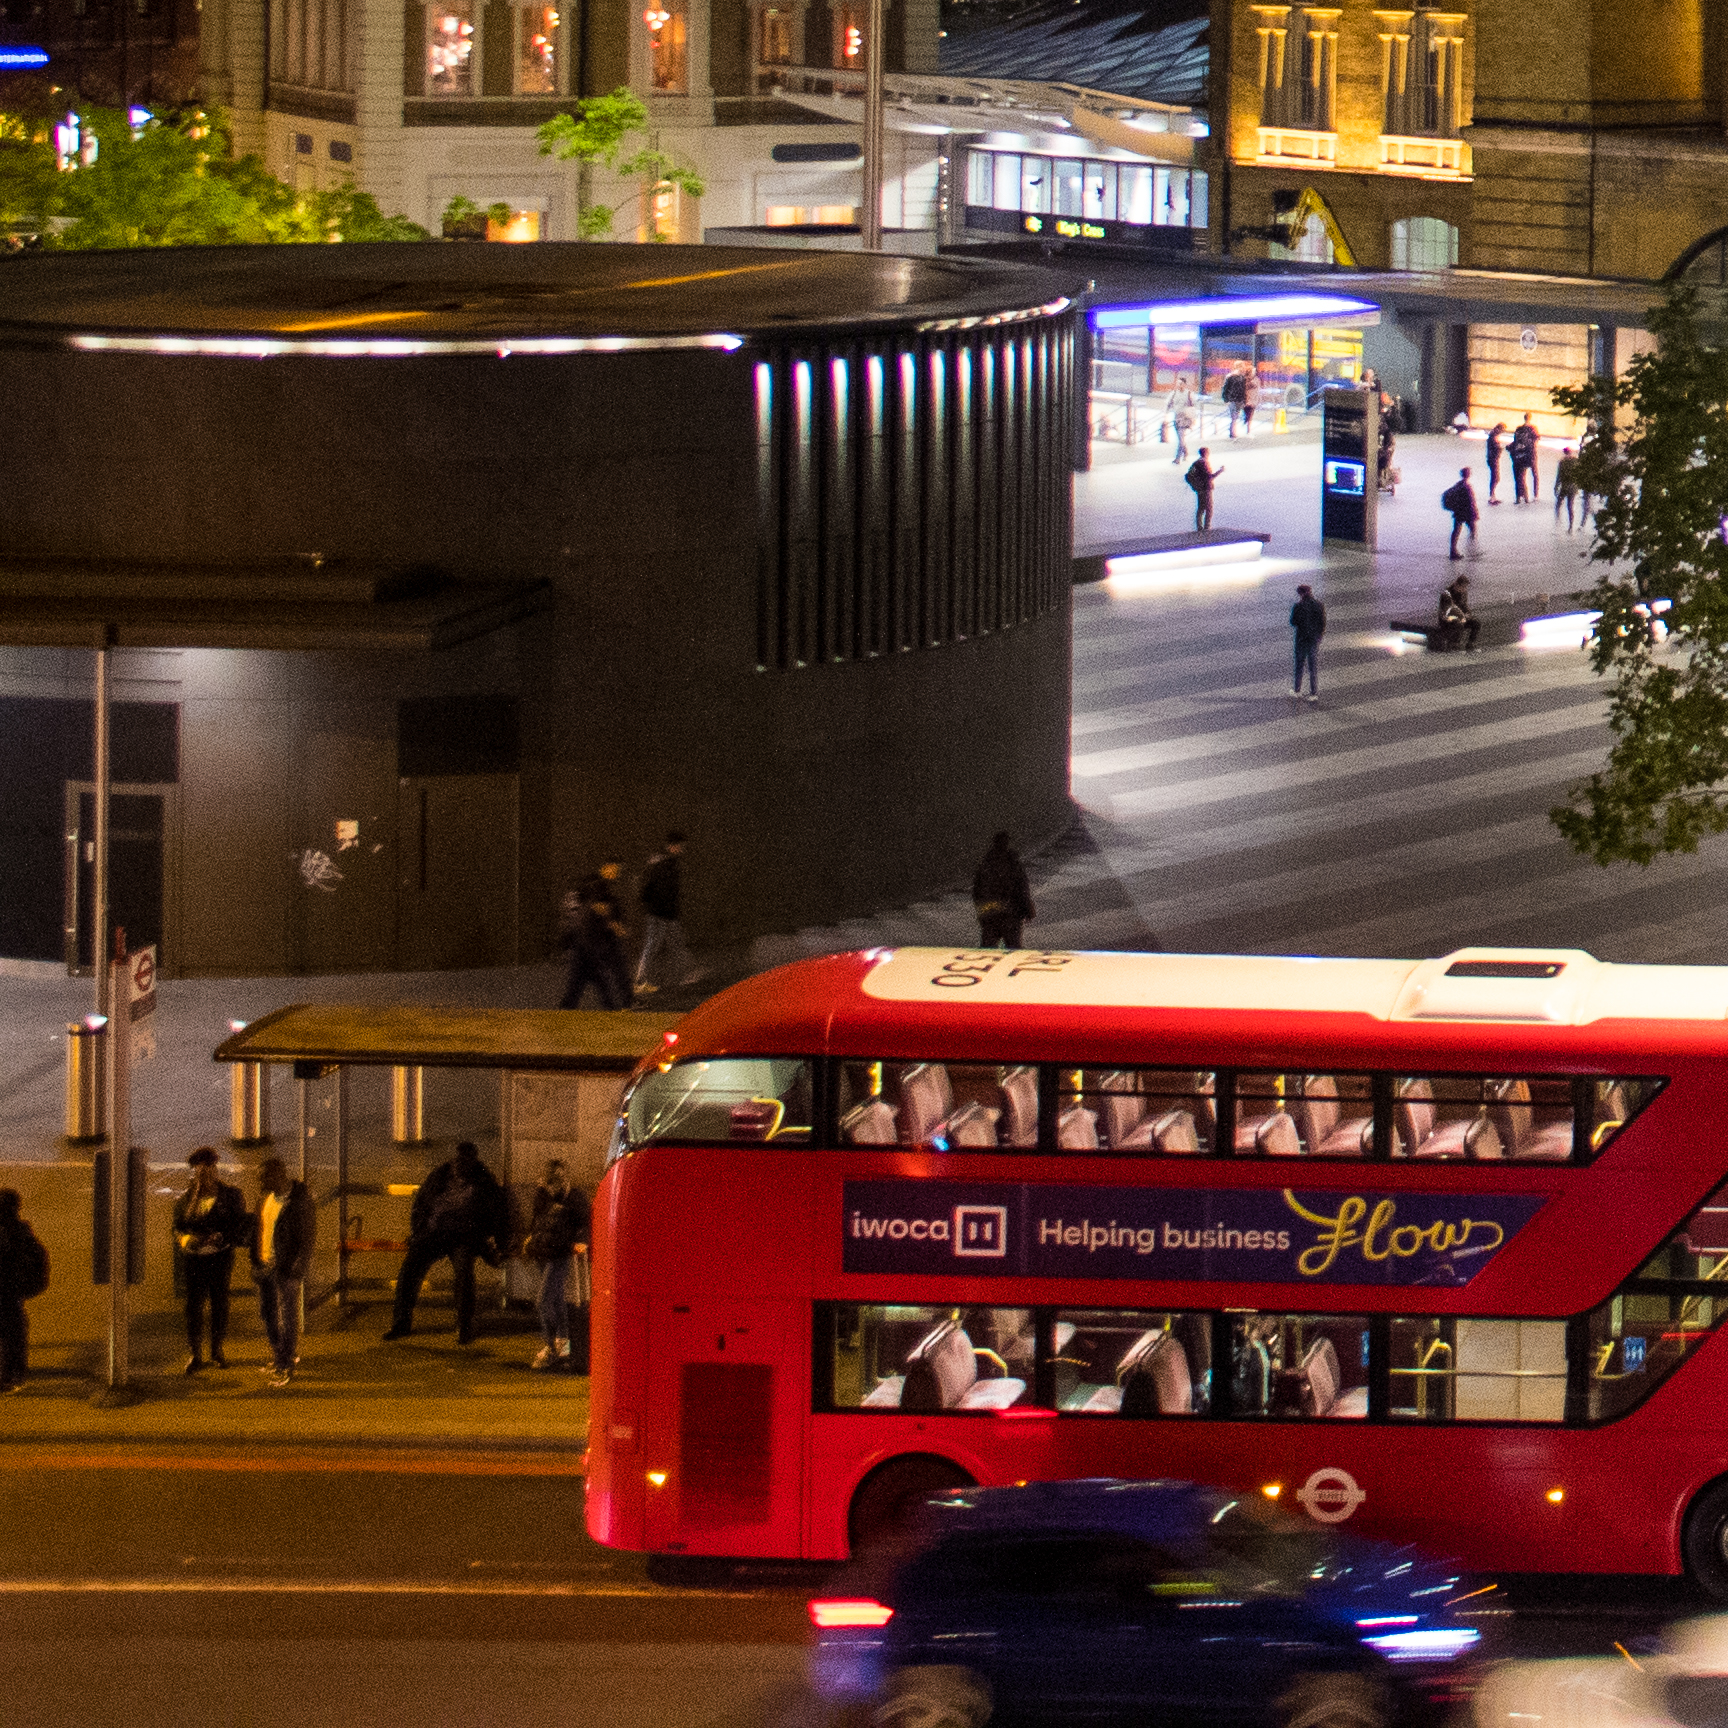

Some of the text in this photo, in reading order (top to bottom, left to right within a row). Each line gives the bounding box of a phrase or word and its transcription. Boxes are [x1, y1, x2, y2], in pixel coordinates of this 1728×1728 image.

[852, 1210, 949, 1240] iwoca
[1039, 1219, 1155, 1254] Helping
[1163, 1222, 1290, 1250] business
